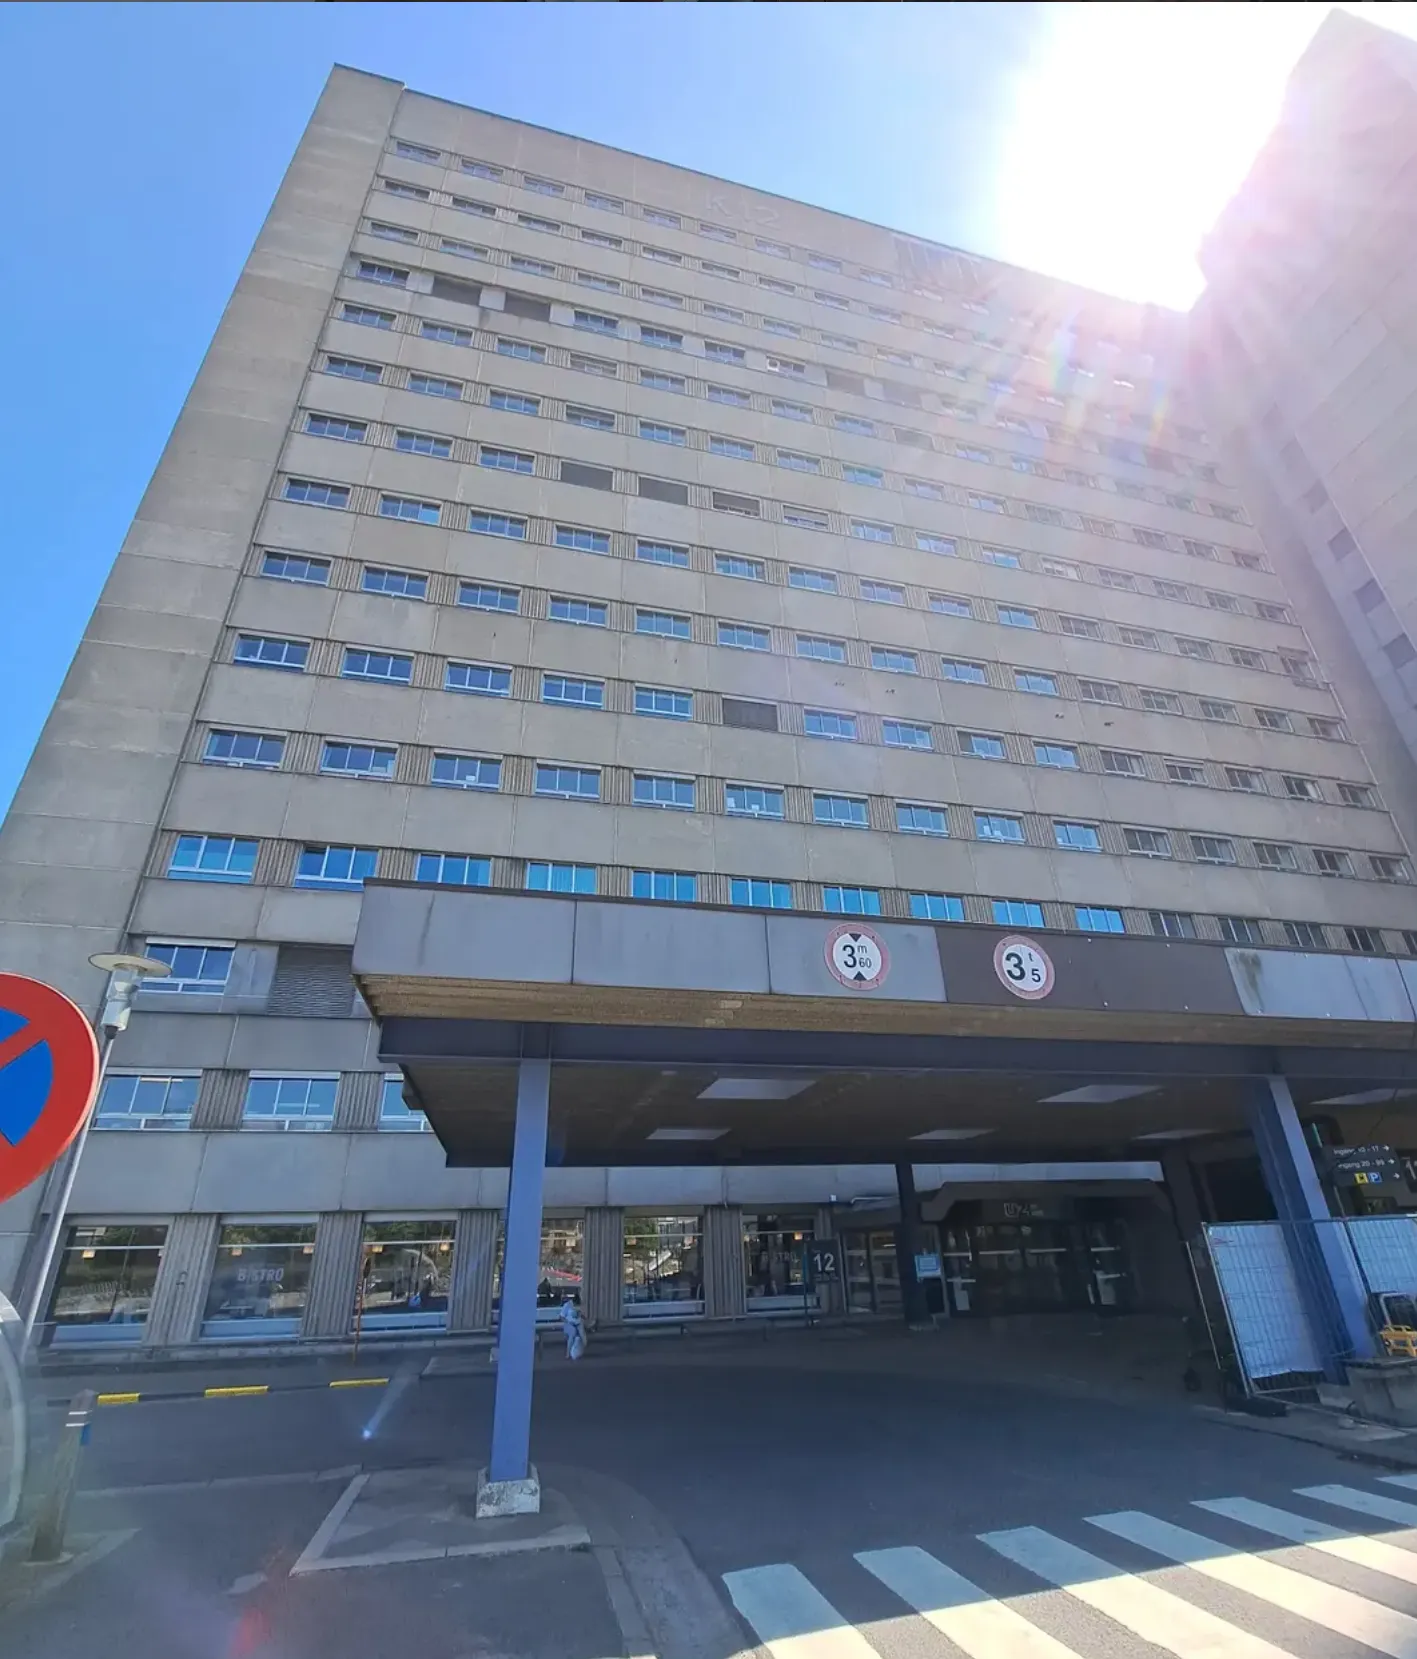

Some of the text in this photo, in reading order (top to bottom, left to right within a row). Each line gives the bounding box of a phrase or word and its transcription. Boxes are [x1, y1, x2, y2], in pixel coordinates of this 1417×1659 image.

[842, 944, 868, 968] 3 m
[858, 957, 872, 969] 60
[1005, 952, 1033, 981] 3 t
[1031, 969, 1041, 983] 5
[813, 1252, 836, 1272] 12
